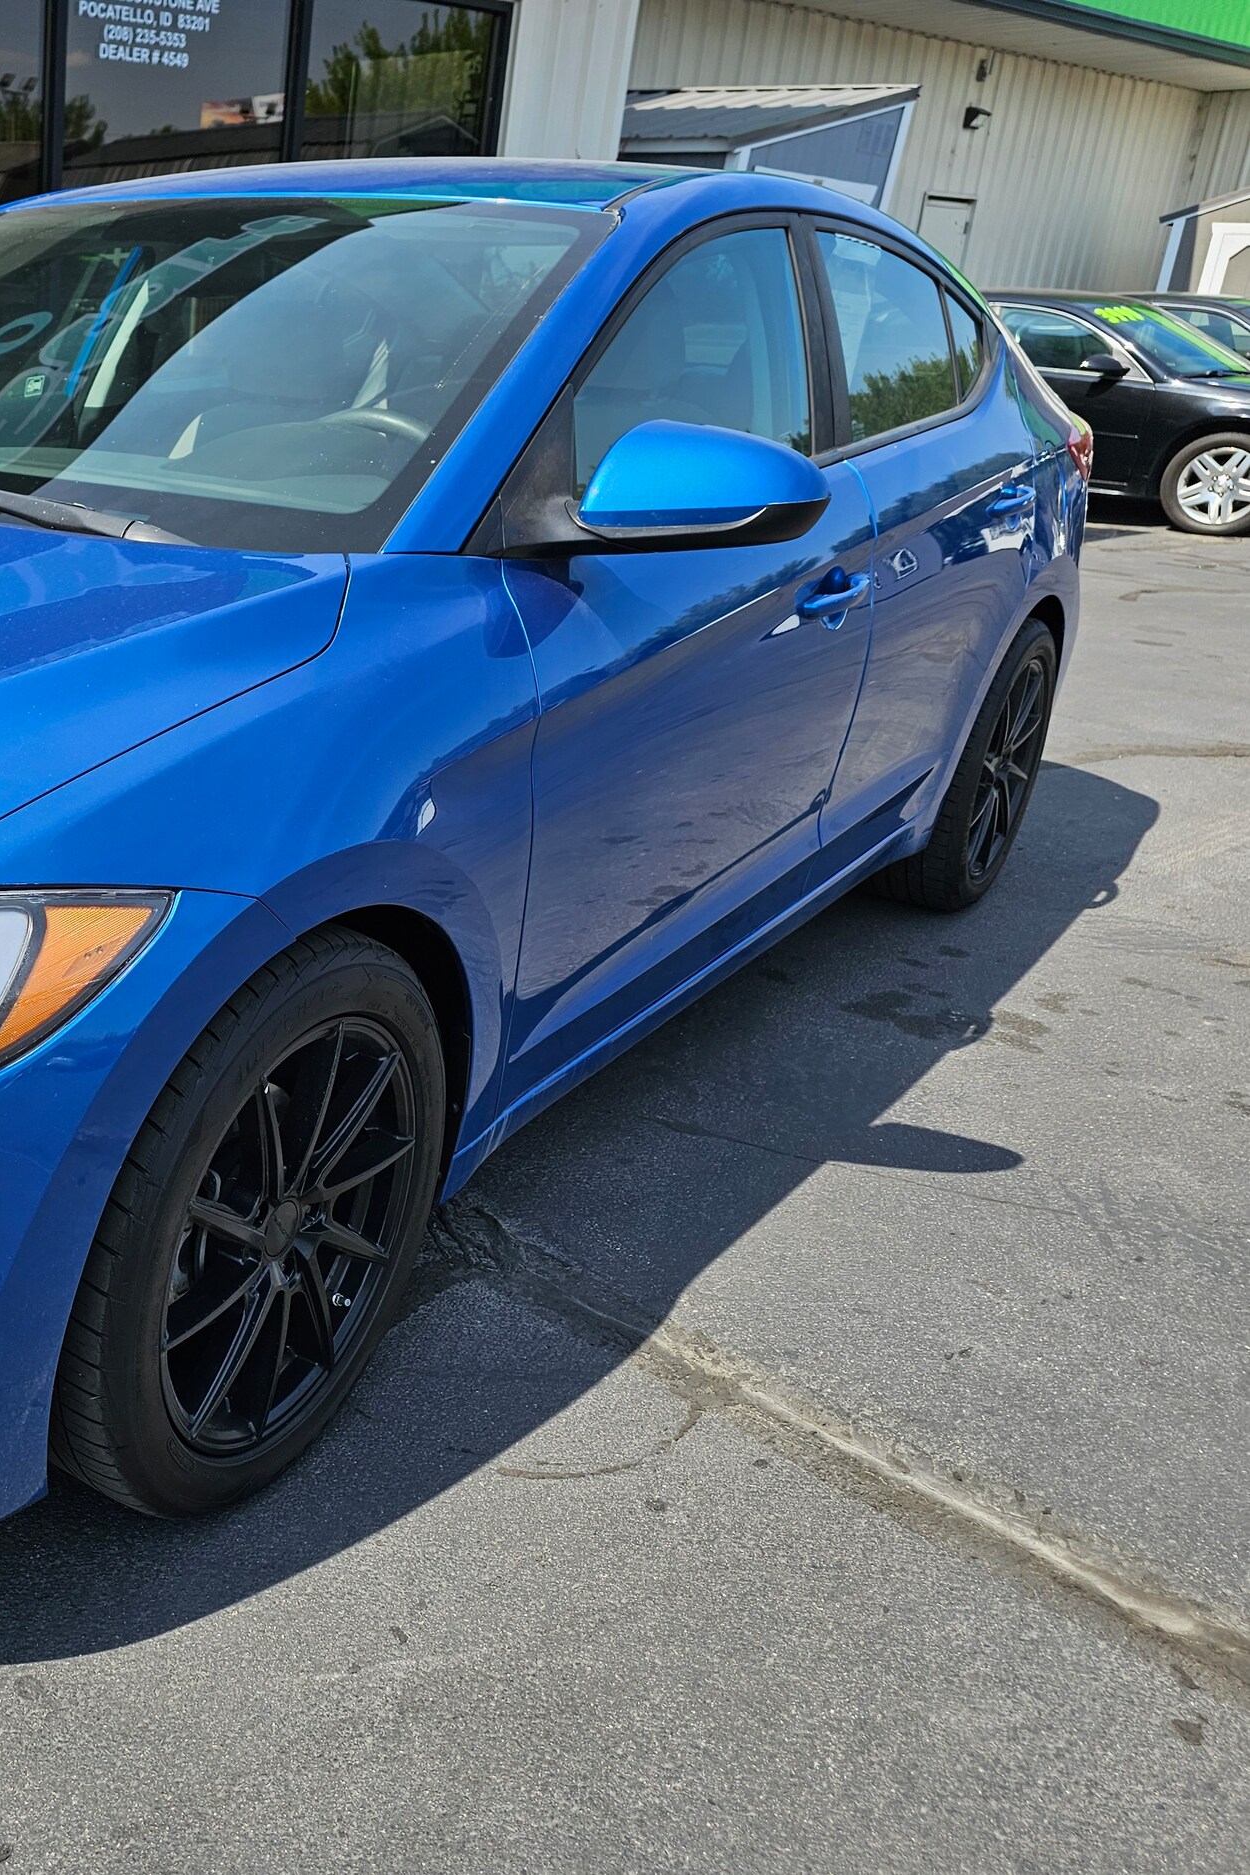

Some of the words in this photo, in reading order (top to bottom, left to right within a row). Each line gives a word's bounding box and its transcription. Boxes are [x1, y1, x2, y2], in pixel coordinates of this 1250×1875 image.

[78, 0, 157, 28] POCATELLO,
[159, 11, 173, 27] ID
[177, 14, 210, 32] 83201
[196, 0, 220, 14] AVE
[103, 24, 133, 45] (208)
[135, 28, 187, 49] 235-5353
[99, 43, 150, 64] DEALER
[151, 49, 160, 65] #
[161, 51, 189, 68] 4549
